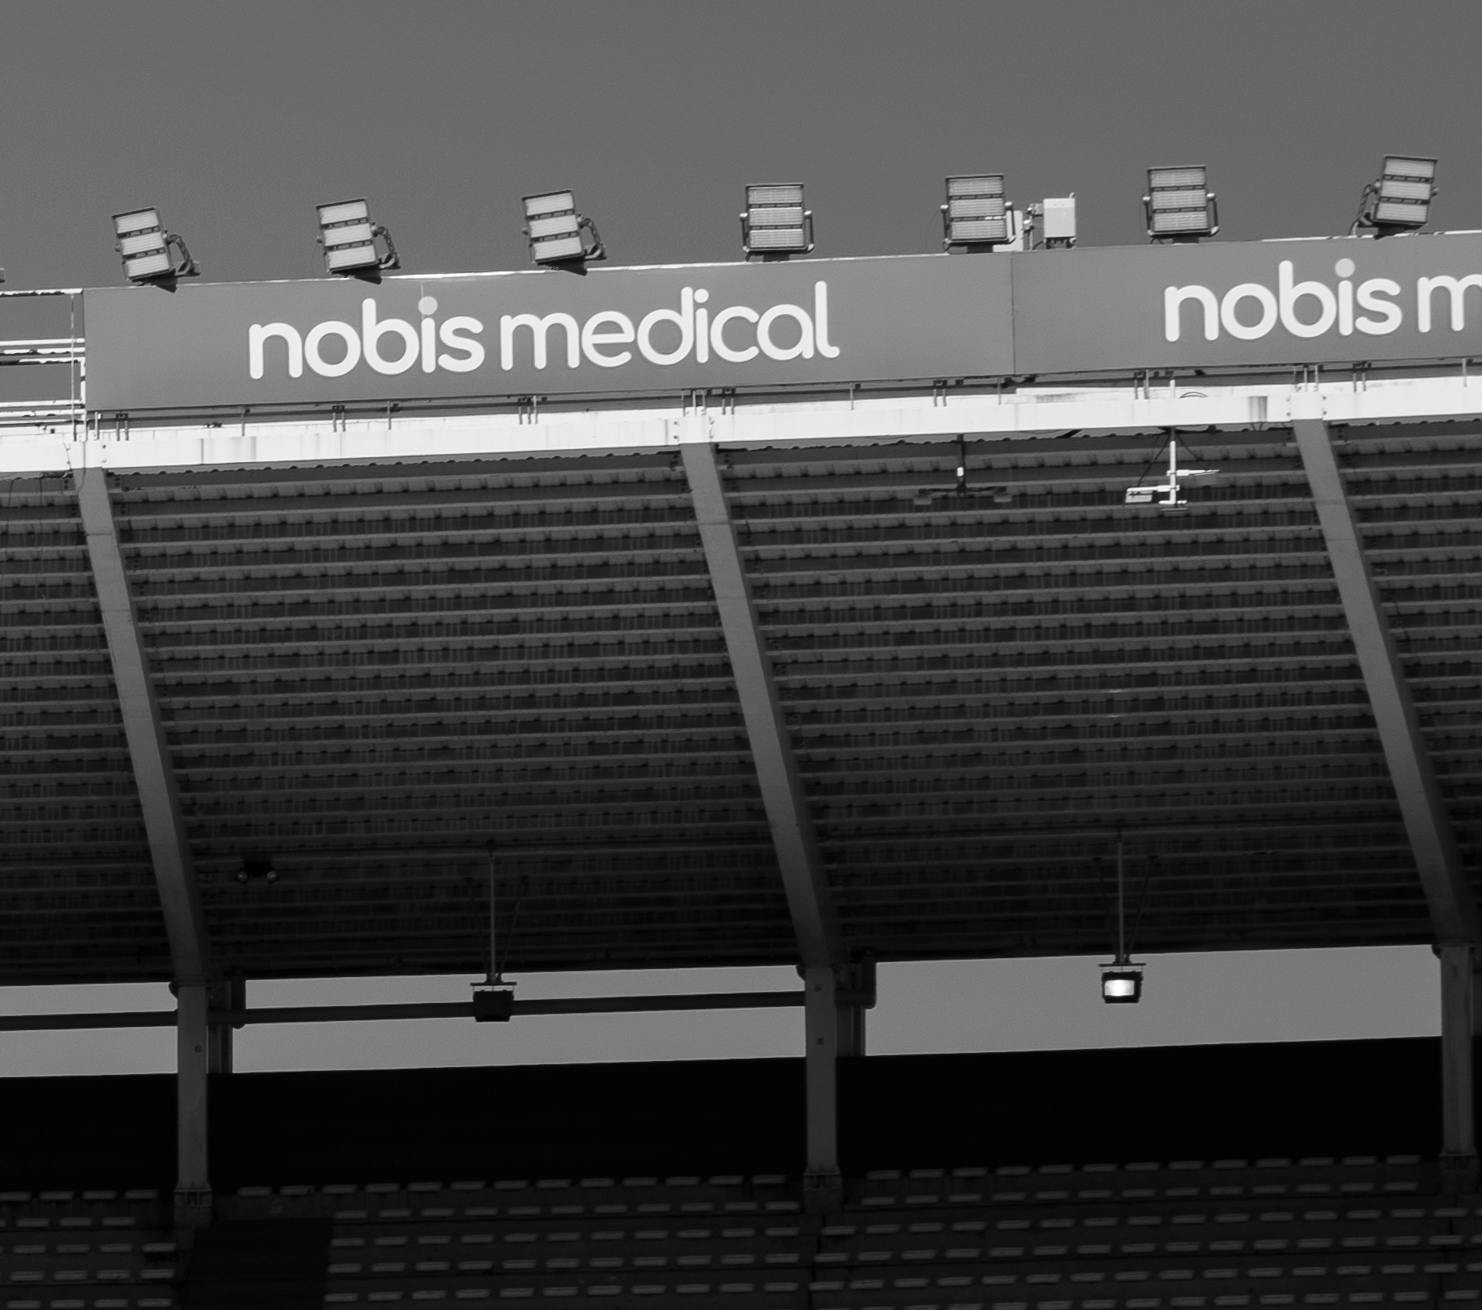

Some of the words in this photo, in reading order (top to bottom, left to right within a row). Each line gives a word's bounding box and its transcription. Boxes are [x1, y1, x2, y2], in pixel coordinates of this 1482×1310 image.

[249, 294, 485, 380] nobis
[500, 280, 841, 371] medical
[1164, 258, 1402, 342] nobis
